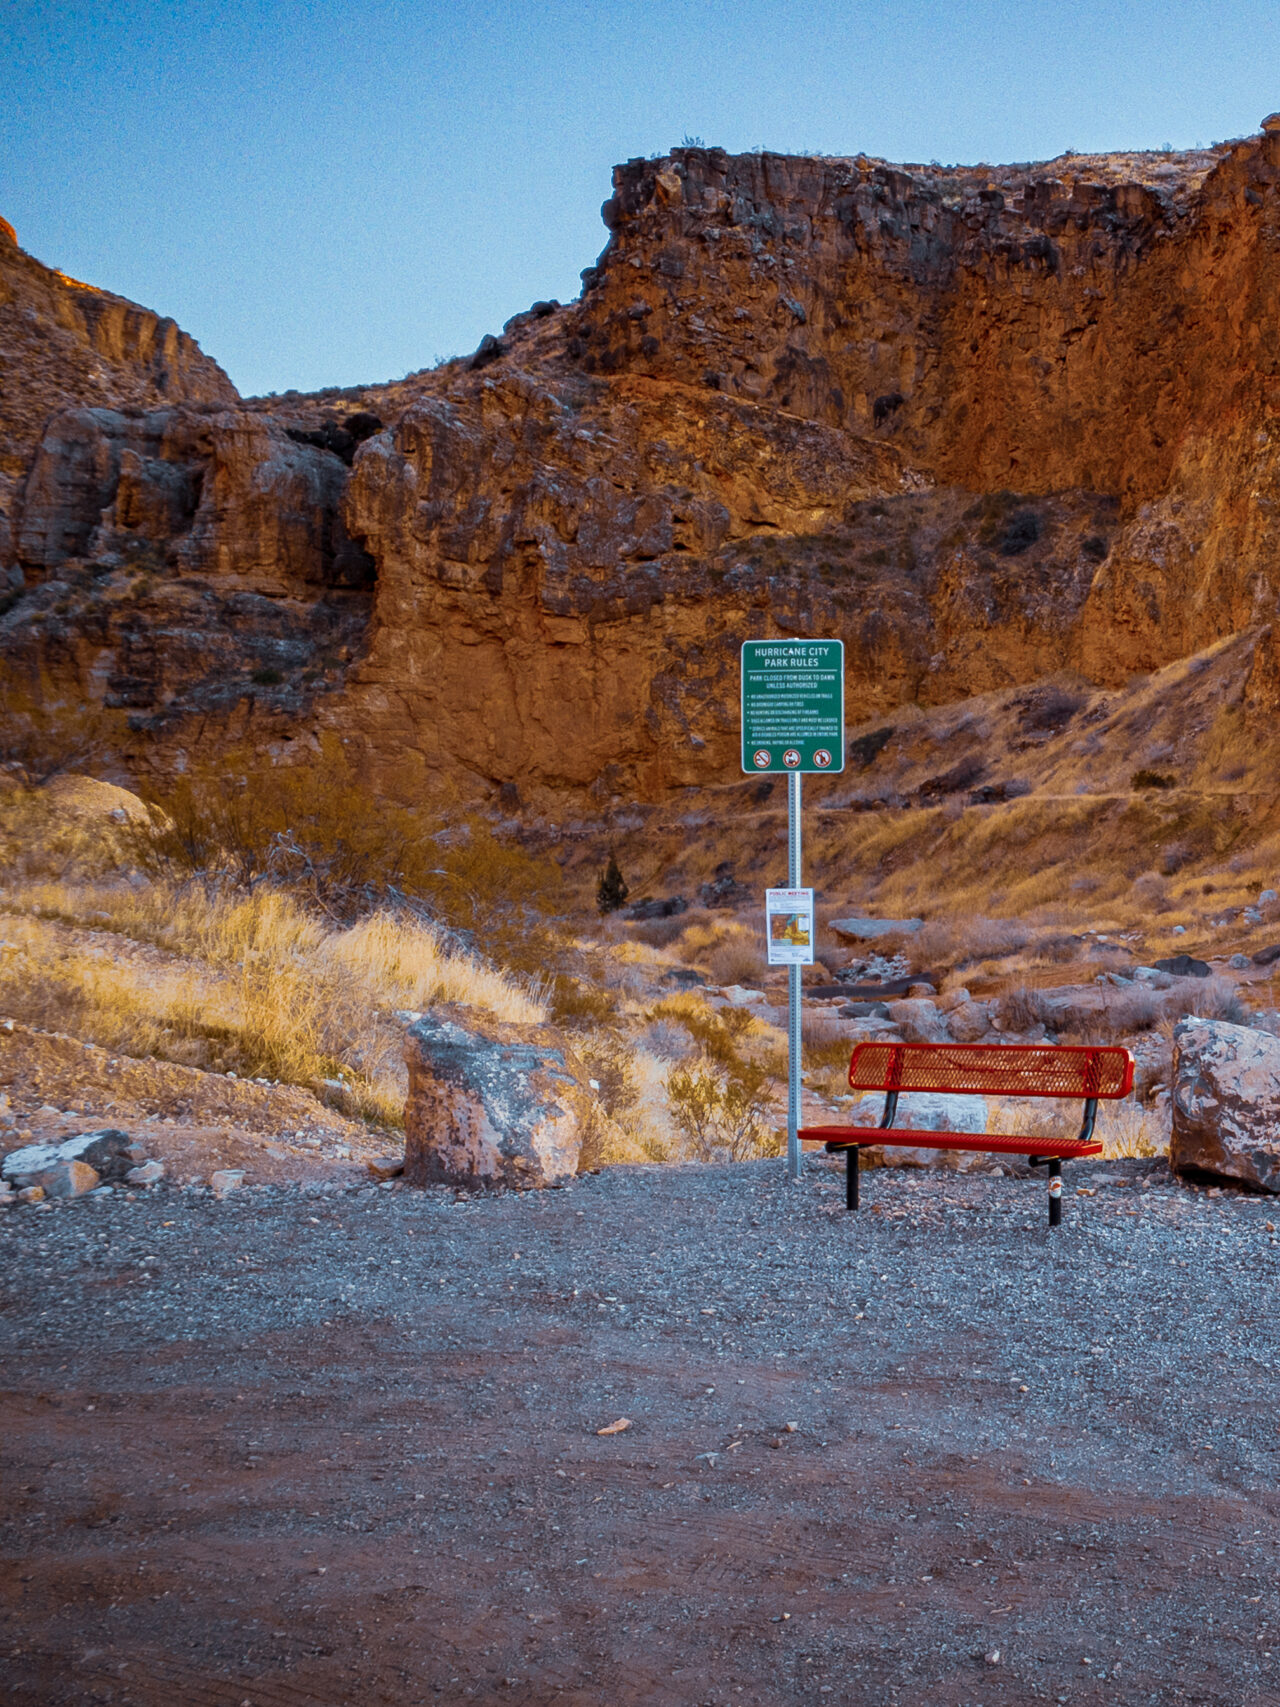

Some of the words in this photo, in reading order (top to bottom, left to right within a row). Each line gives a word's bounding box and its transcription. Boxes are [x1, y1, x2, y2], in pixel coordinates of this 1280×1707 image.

[755, 648, 807, 656] HURRICANE
[808, 648, 829, 656] CITY
[764, 659, 788, 667] PARK
[790, 658, 818, 666] RULES
